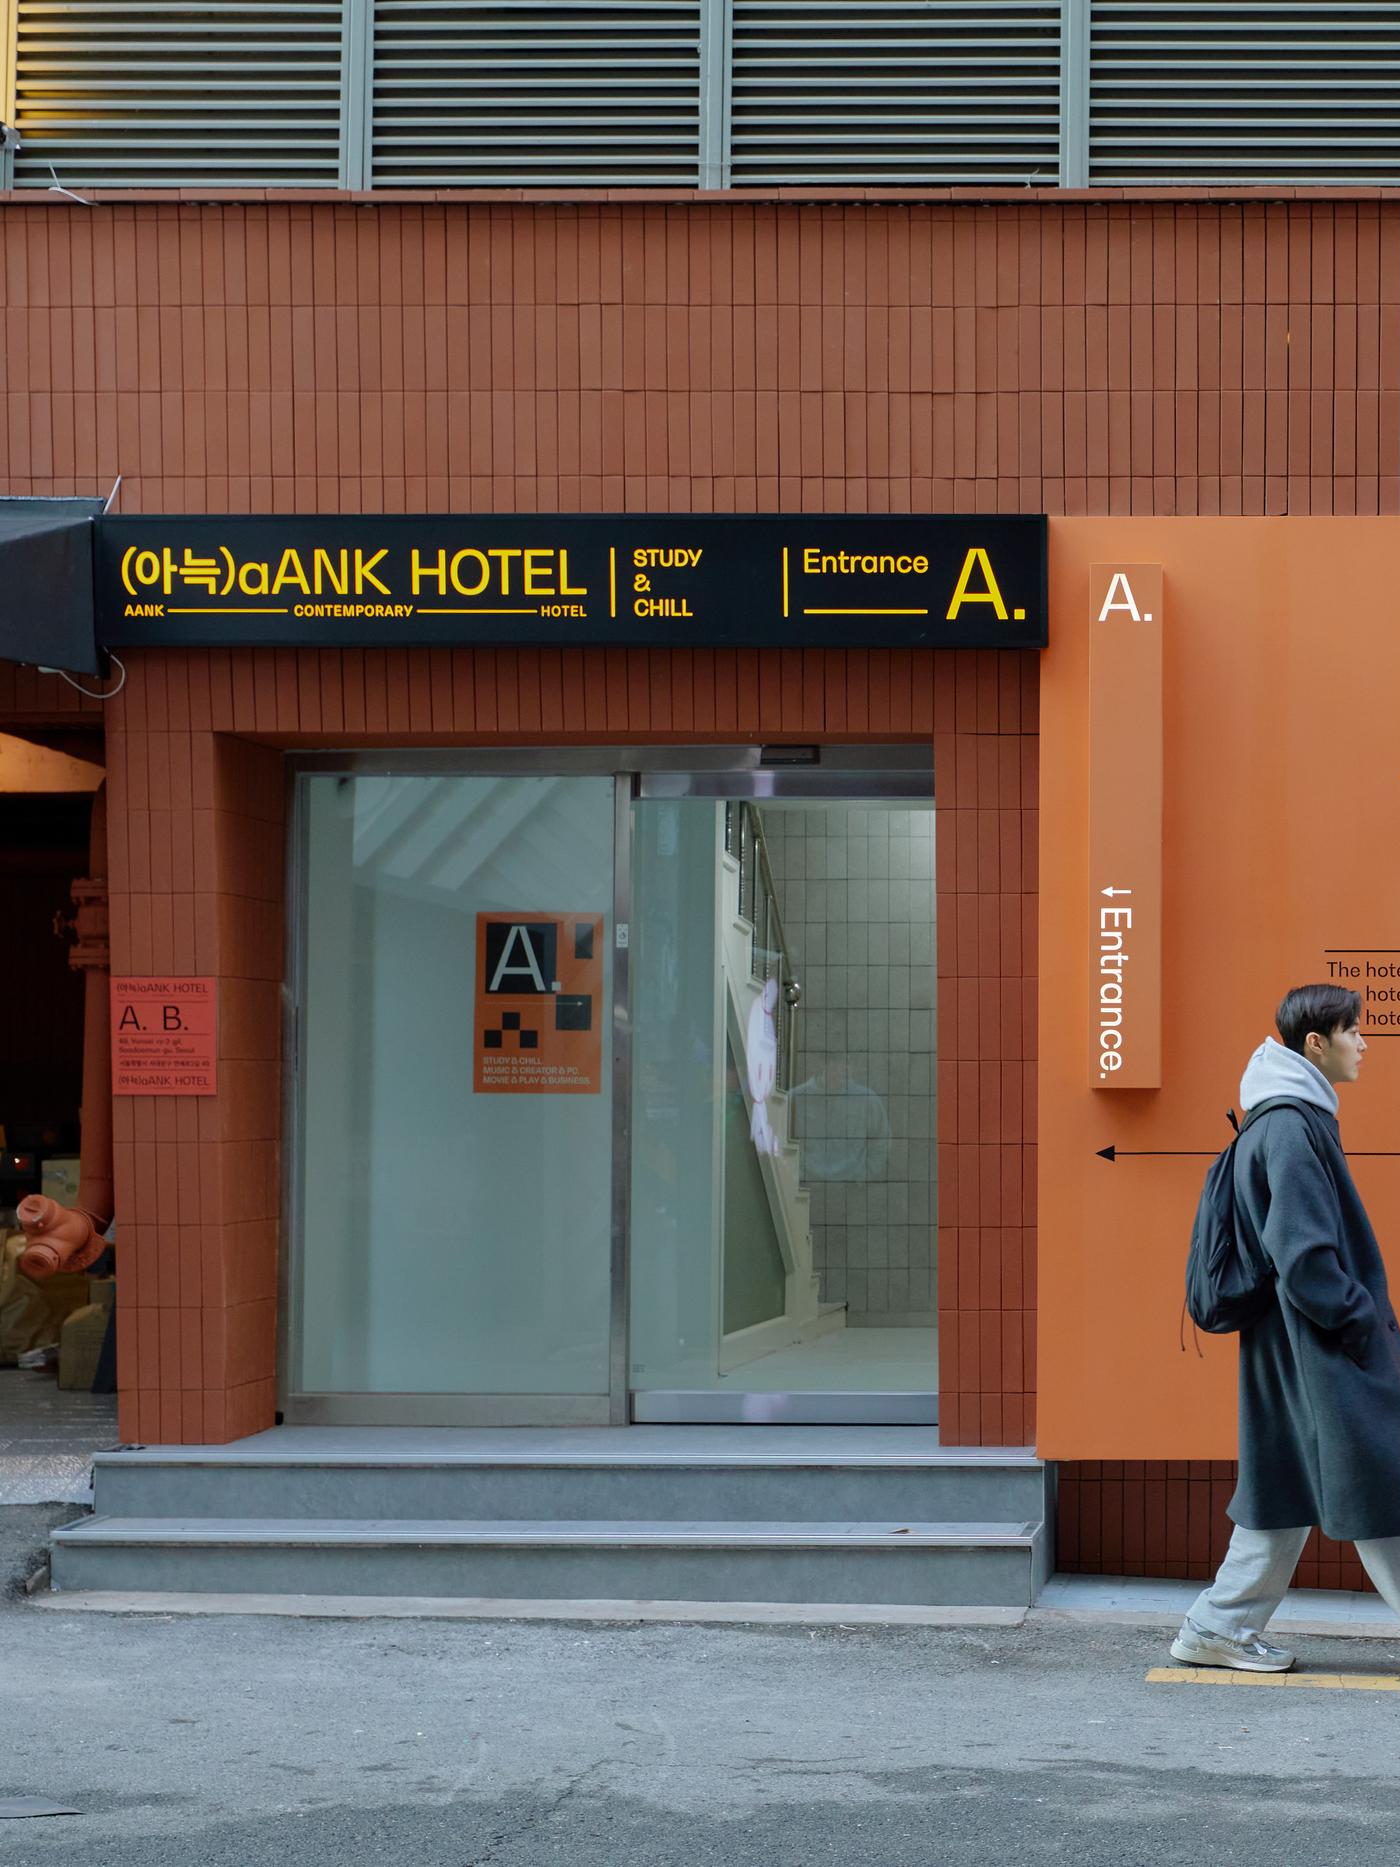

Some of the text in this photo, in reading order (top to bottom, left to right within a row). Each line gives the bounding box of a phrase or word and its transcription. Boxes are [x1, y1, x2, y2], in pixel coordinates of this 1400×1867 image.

[633, 548, 703, 568] STUDY
[804, 548, 929, 574] Entrance
[121, 545, 588, 596] (아늑)aANK HOTEL
[633, 573, 651, 592] &
[945, 547, 1026, 620] A.
[1098, 573, 1153, 622] A.
[124, 604, 587, 618] AANK CONTEMPORARY HOTEL
[633, 598, 694, 617] CHILL
[489, 926, 562, 991] A.
[1326, 960, 1361, 978] The
[174, 983, 209, 993] HOTEL
[1099, 907, 1133, 1079] Entrance.
[119, 1005, 188, 1031] A. B.
[483, 1066, 510, 1074] MUSIC
[519, 1066, 558, 1074] CREATOR
[175, 1076, 209, 1086] HOTEL
[483, 1076, 509, 1084] MOVIE
[519, 1076, 541, 1084] PLAY
